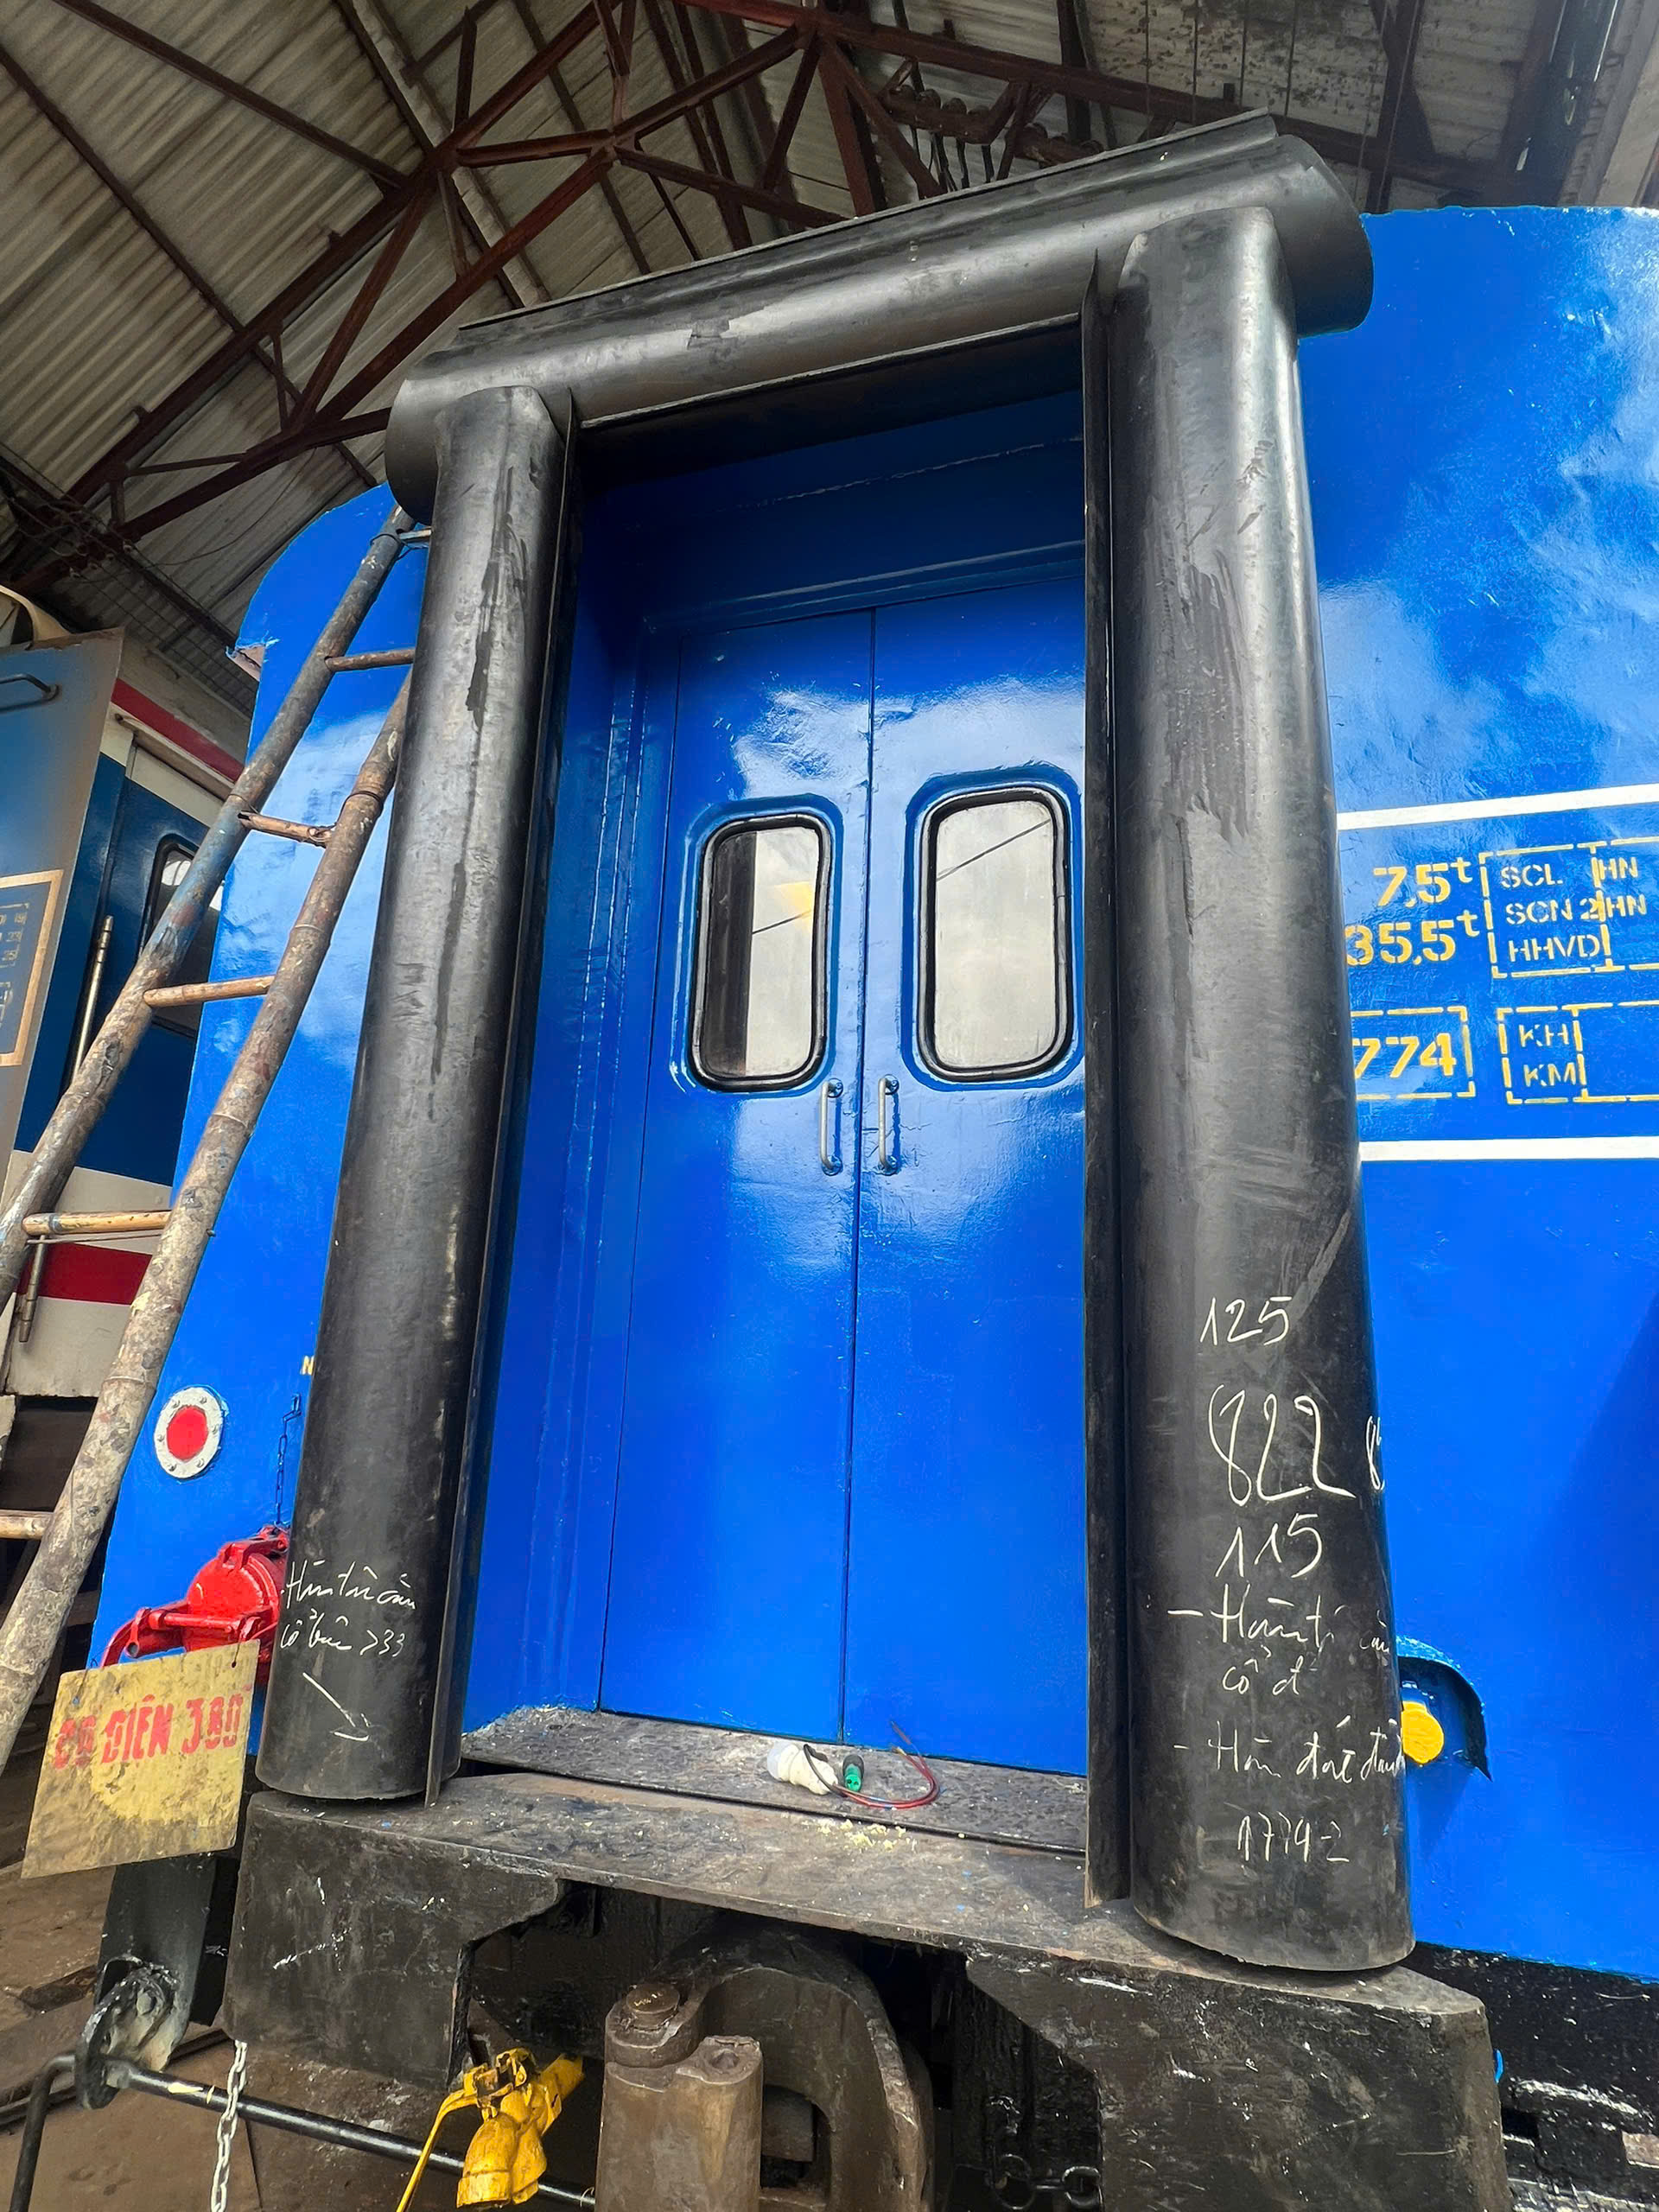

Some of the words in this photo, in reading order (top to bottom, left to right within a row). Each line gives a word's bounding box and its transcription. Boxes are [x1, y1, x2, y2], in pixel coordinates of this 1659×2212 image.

[1505, 898, 1573, 925] SCN
[1605, 893, 1647, 918] HN
[1518, 1023, 1570, 1048] KH
[1523, 1062, 1577, 1088] KM
[1200, 1297, 1293, 1346] 125
